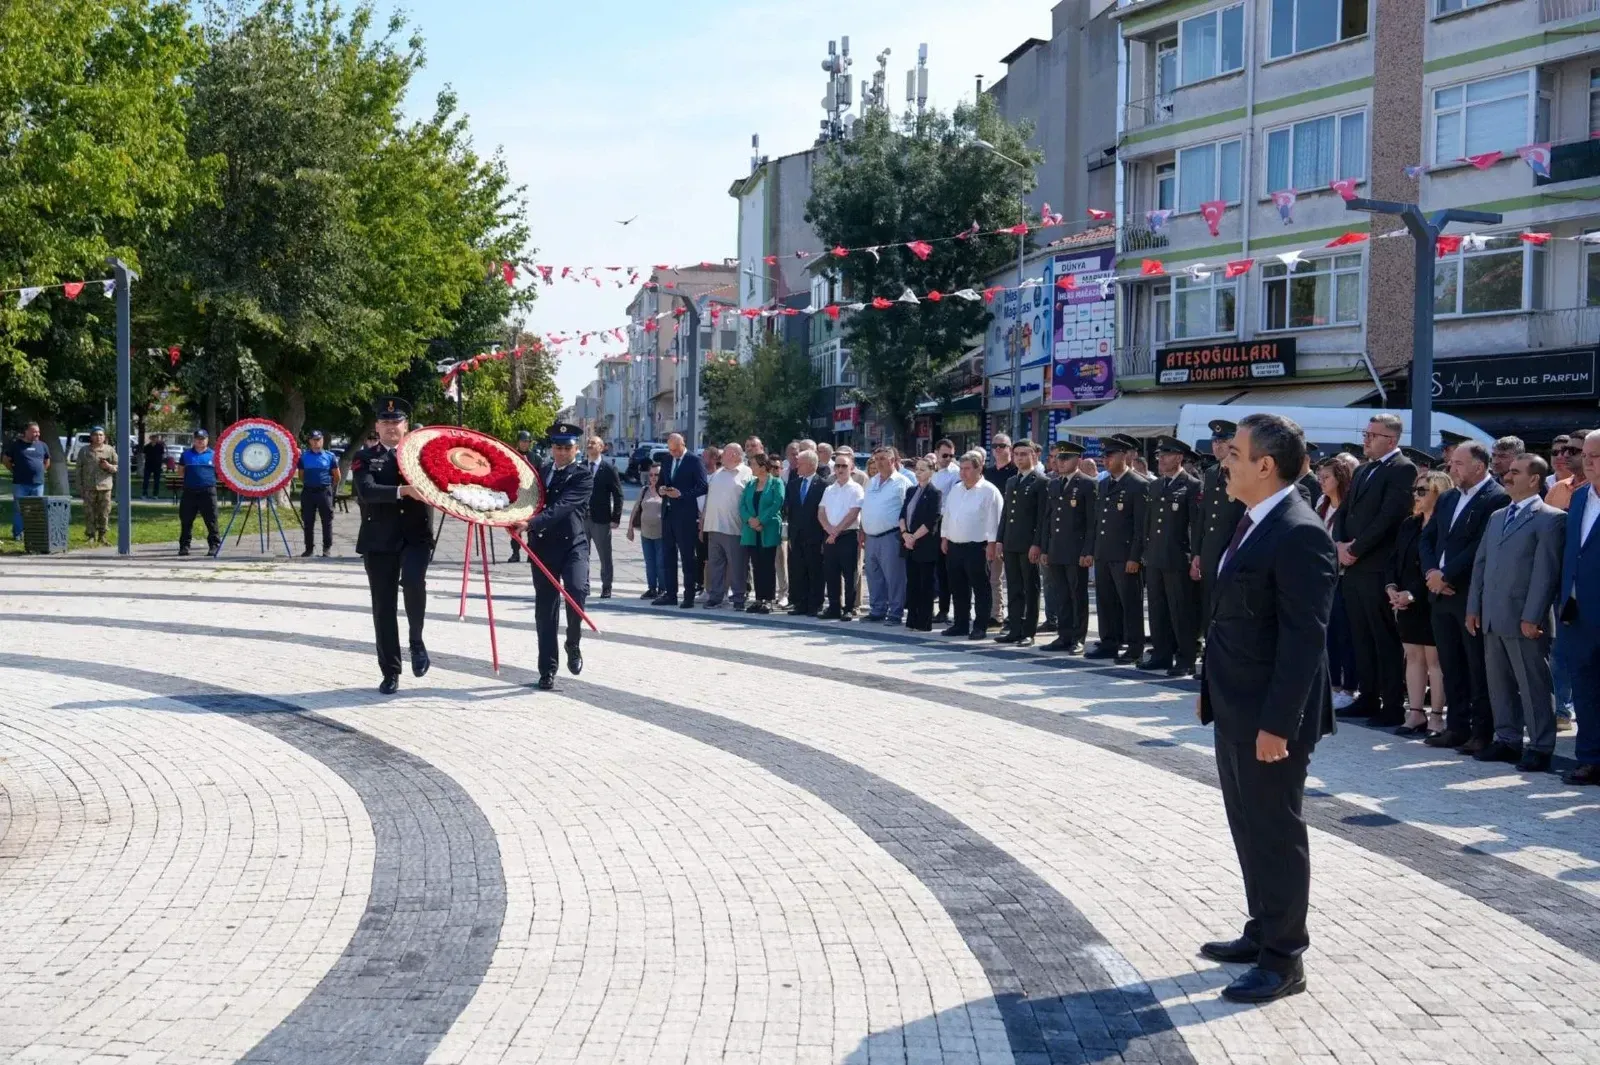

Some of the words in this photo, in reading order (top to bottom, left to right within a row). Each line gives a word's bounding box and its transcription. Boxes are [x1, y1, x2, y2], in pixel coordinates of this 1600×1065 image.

[1061, 261, 1086, 272] DÜNYA
[1166, 344, 1277, 369] ATEŞOĞULLARI
[1190, 366, 1249, 381] LOKANTASI
